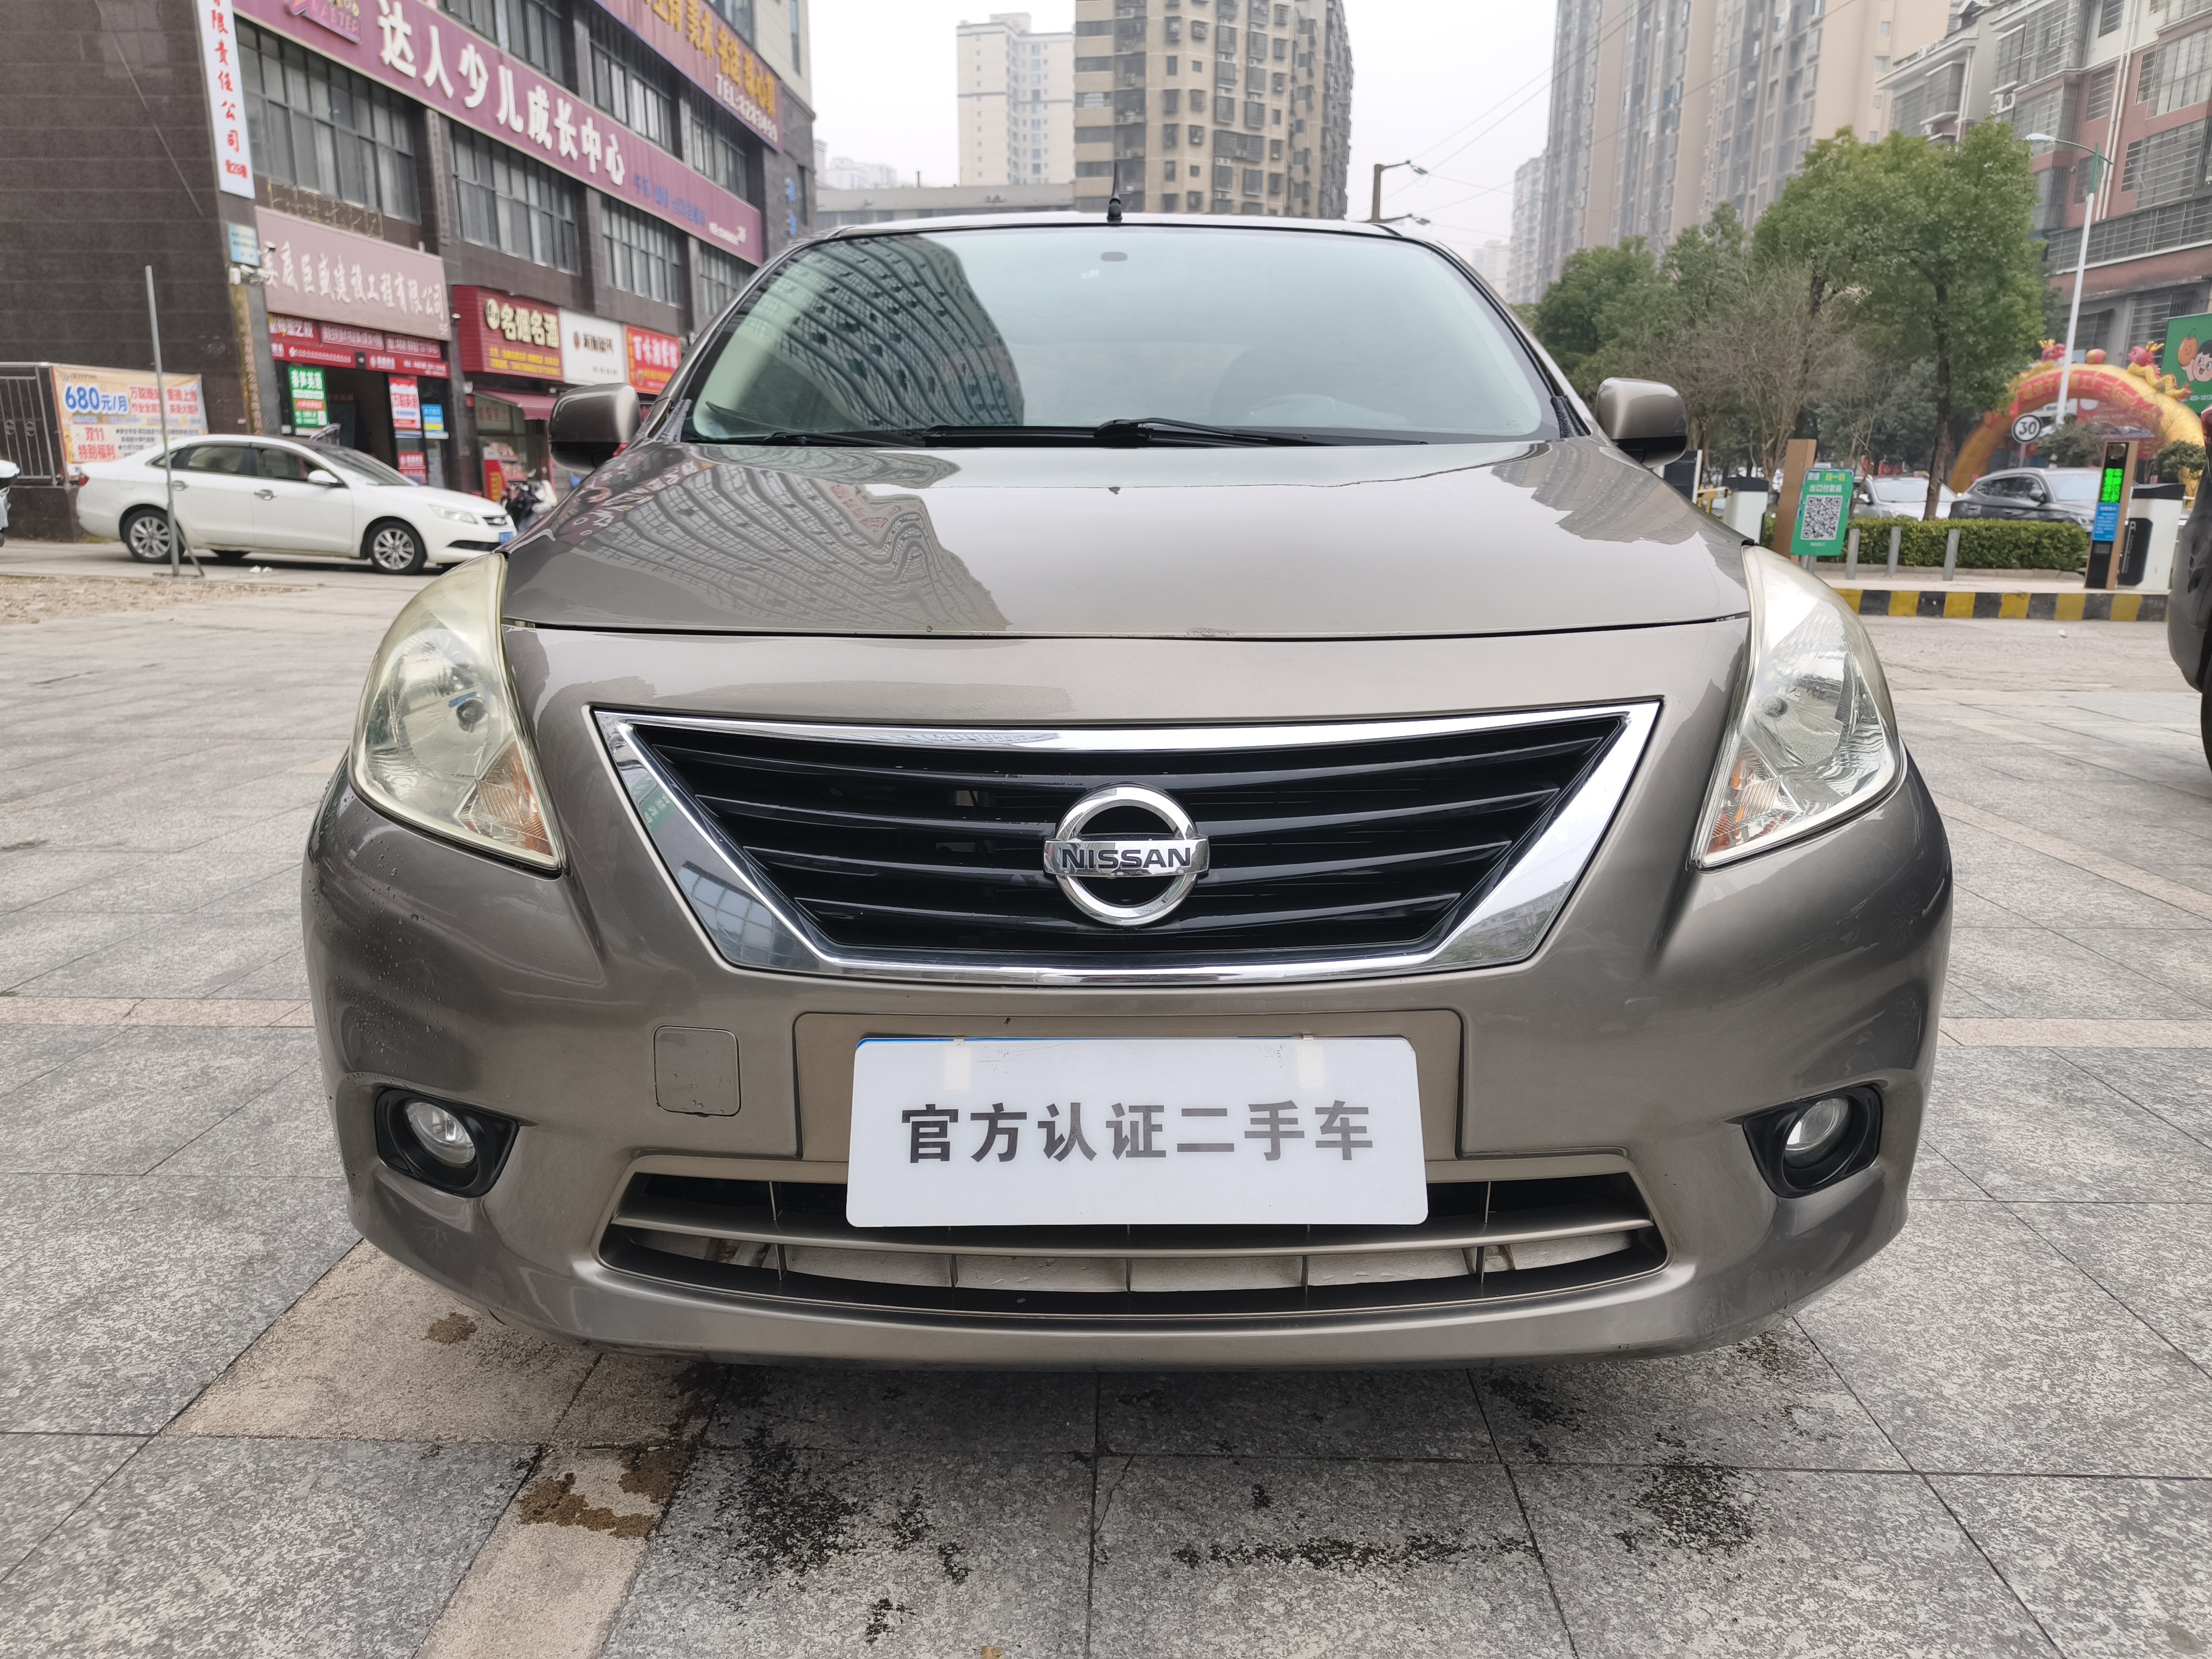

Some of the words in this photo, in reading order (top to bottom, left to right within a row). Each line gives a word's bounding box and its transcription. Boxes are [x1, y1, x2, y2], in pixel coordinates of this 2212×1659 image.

[211, 0, 240, 153] 限责任公司
[377, 0, 625, 186] 达人少儿成长中心
[500, 302, 560, 348] 名烟名酒
[65, 385, 127, 412] 680元/月
[2019, 421, 2037, 435] 30
[1062, 847, 1191, 869] NISSAN
[901, 1100, 1373, 1163] 官方认证二手车
